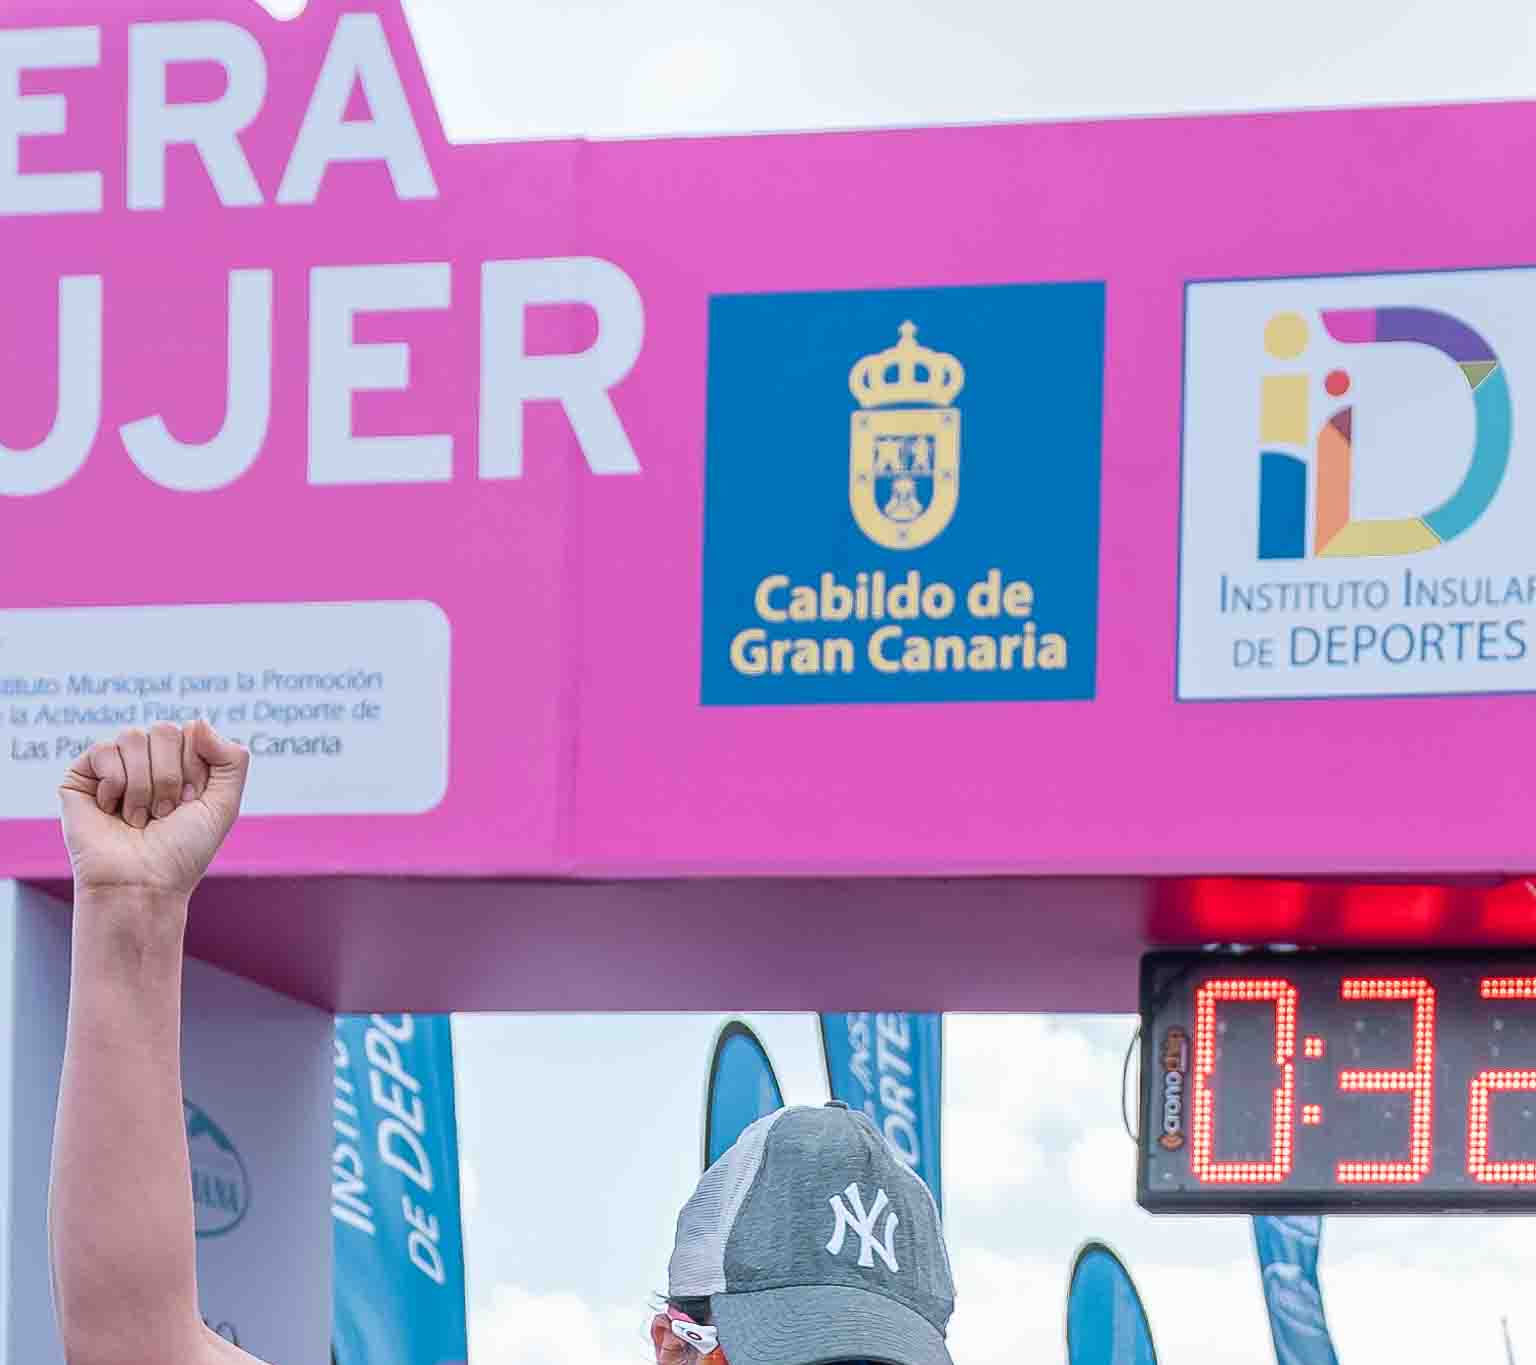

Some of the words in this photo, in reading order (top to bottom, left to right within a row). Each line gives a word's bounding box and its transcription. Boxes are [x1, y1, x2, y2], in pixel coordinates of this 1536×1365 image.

[754, 571, 955, 623] Cabildo
[967, 569, 1034, 617] de
[1220, 573, 1390, 613] INSTITUTO
[730, 629, 854, 677] Gran
[868, 623, 1068, 674] Canaria
[1233, 637, 1273, 668] DE
[1289, 619, 1528, 667] DEPORTES
[66, 673, 174, 699] Municipal
[180, 675, 229, 699] para
[237, 670, 255, 691] la
[263, 667, 383, 692] Promoción
[10, 702, 29, 726] la
[34, 700, 136, 725] Actividad
[201, 704, 219, 726] y
[227, 699, 246, 722] el
[252, 699, 345, 725] Deporte
[351, 698, 381, 720] de
[11, 737, 50, 760] Las
[249, 732, 343, 758] Canaria
[401, 1193, 446, 1286] DE
[825, 1182, 899, 1273] NY
